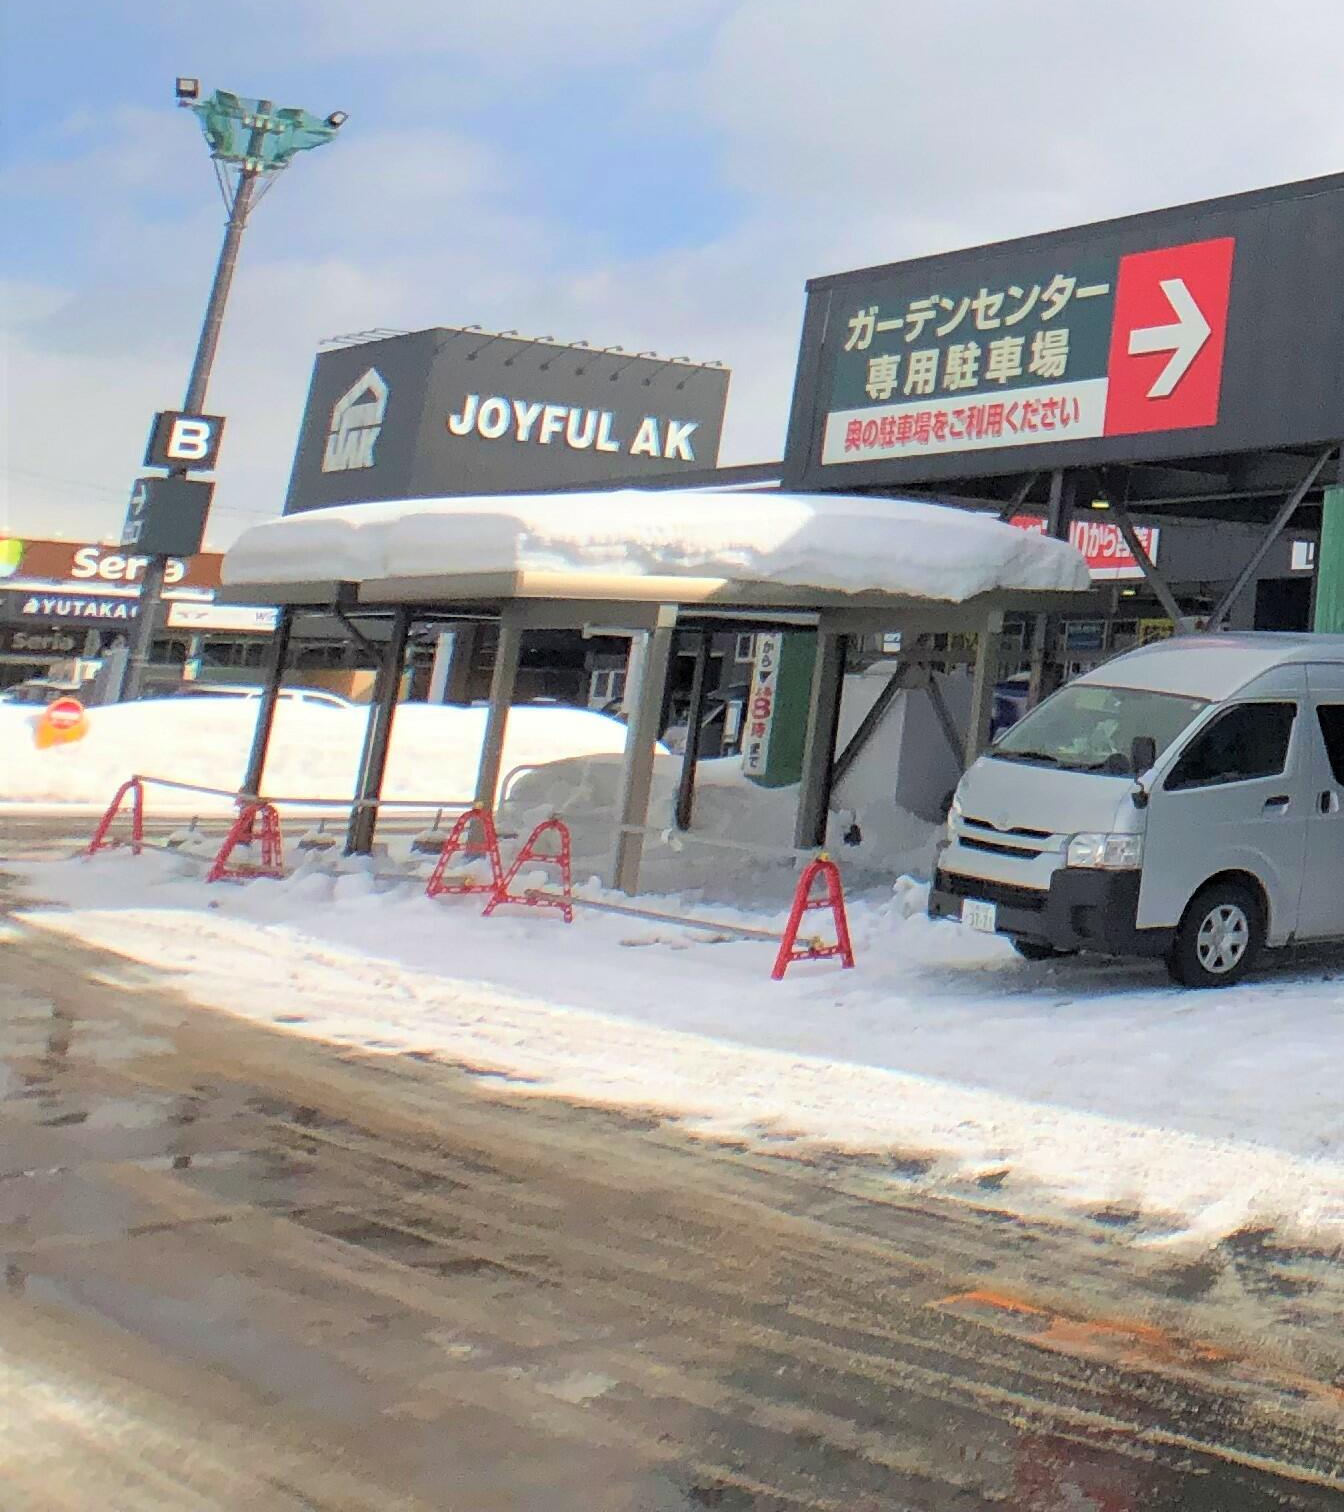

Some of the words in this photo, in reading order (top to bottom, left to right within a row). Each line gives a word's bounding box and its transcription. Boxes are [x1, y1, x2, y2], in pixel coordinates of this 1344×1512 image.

[844, 274, 1110, 352] ガーデンセンター
[865, 328, 1070, 400] 専用駐車場
[167, 419, 211, 460] B
[447, 394, 620, 453] JOYFUL
[629, 415, 699, 462] AK
[844, 397, 1081, 452] 奥の駐車場をご利用ください
[71, 547, 187, 583] Sera
